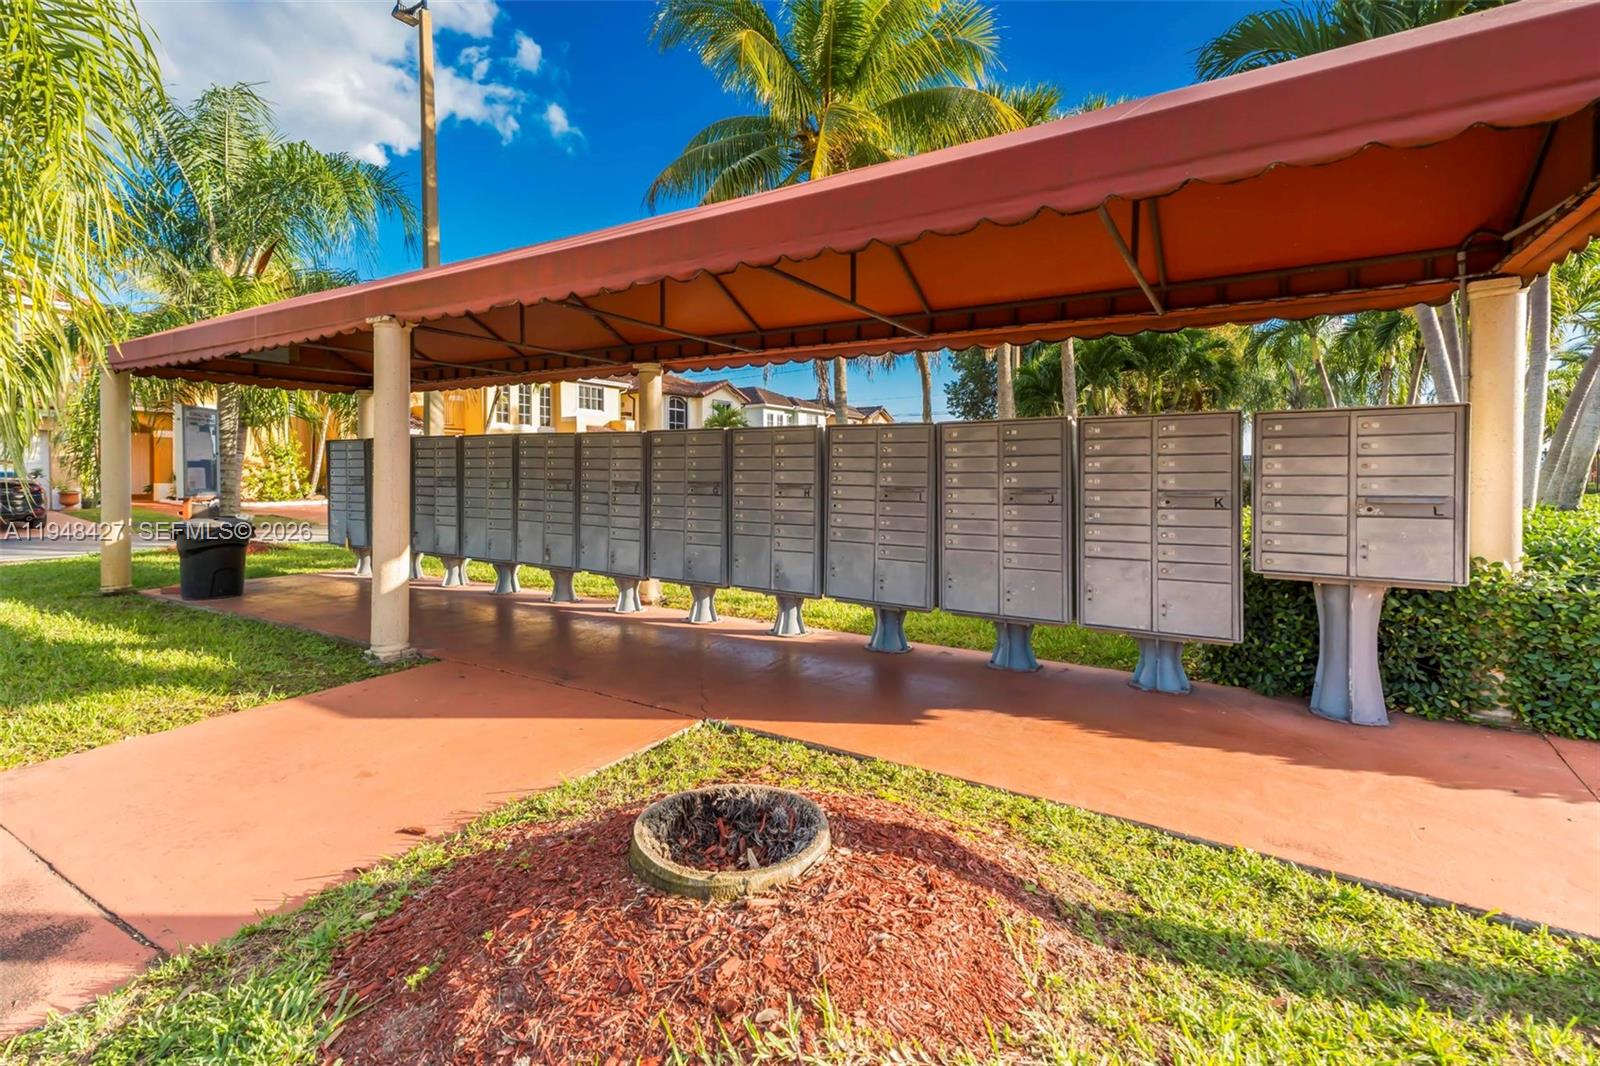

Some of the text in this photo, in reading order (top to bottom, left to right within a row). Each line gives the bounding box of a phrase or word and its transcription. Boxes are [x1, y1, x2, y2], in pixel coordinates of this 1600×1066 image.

[804, 488, 811, 496] H
[1047, 495, 1054, 503] J
[1214, 497, 1224, 508] K
[1433, 505, 1444, 516] L
